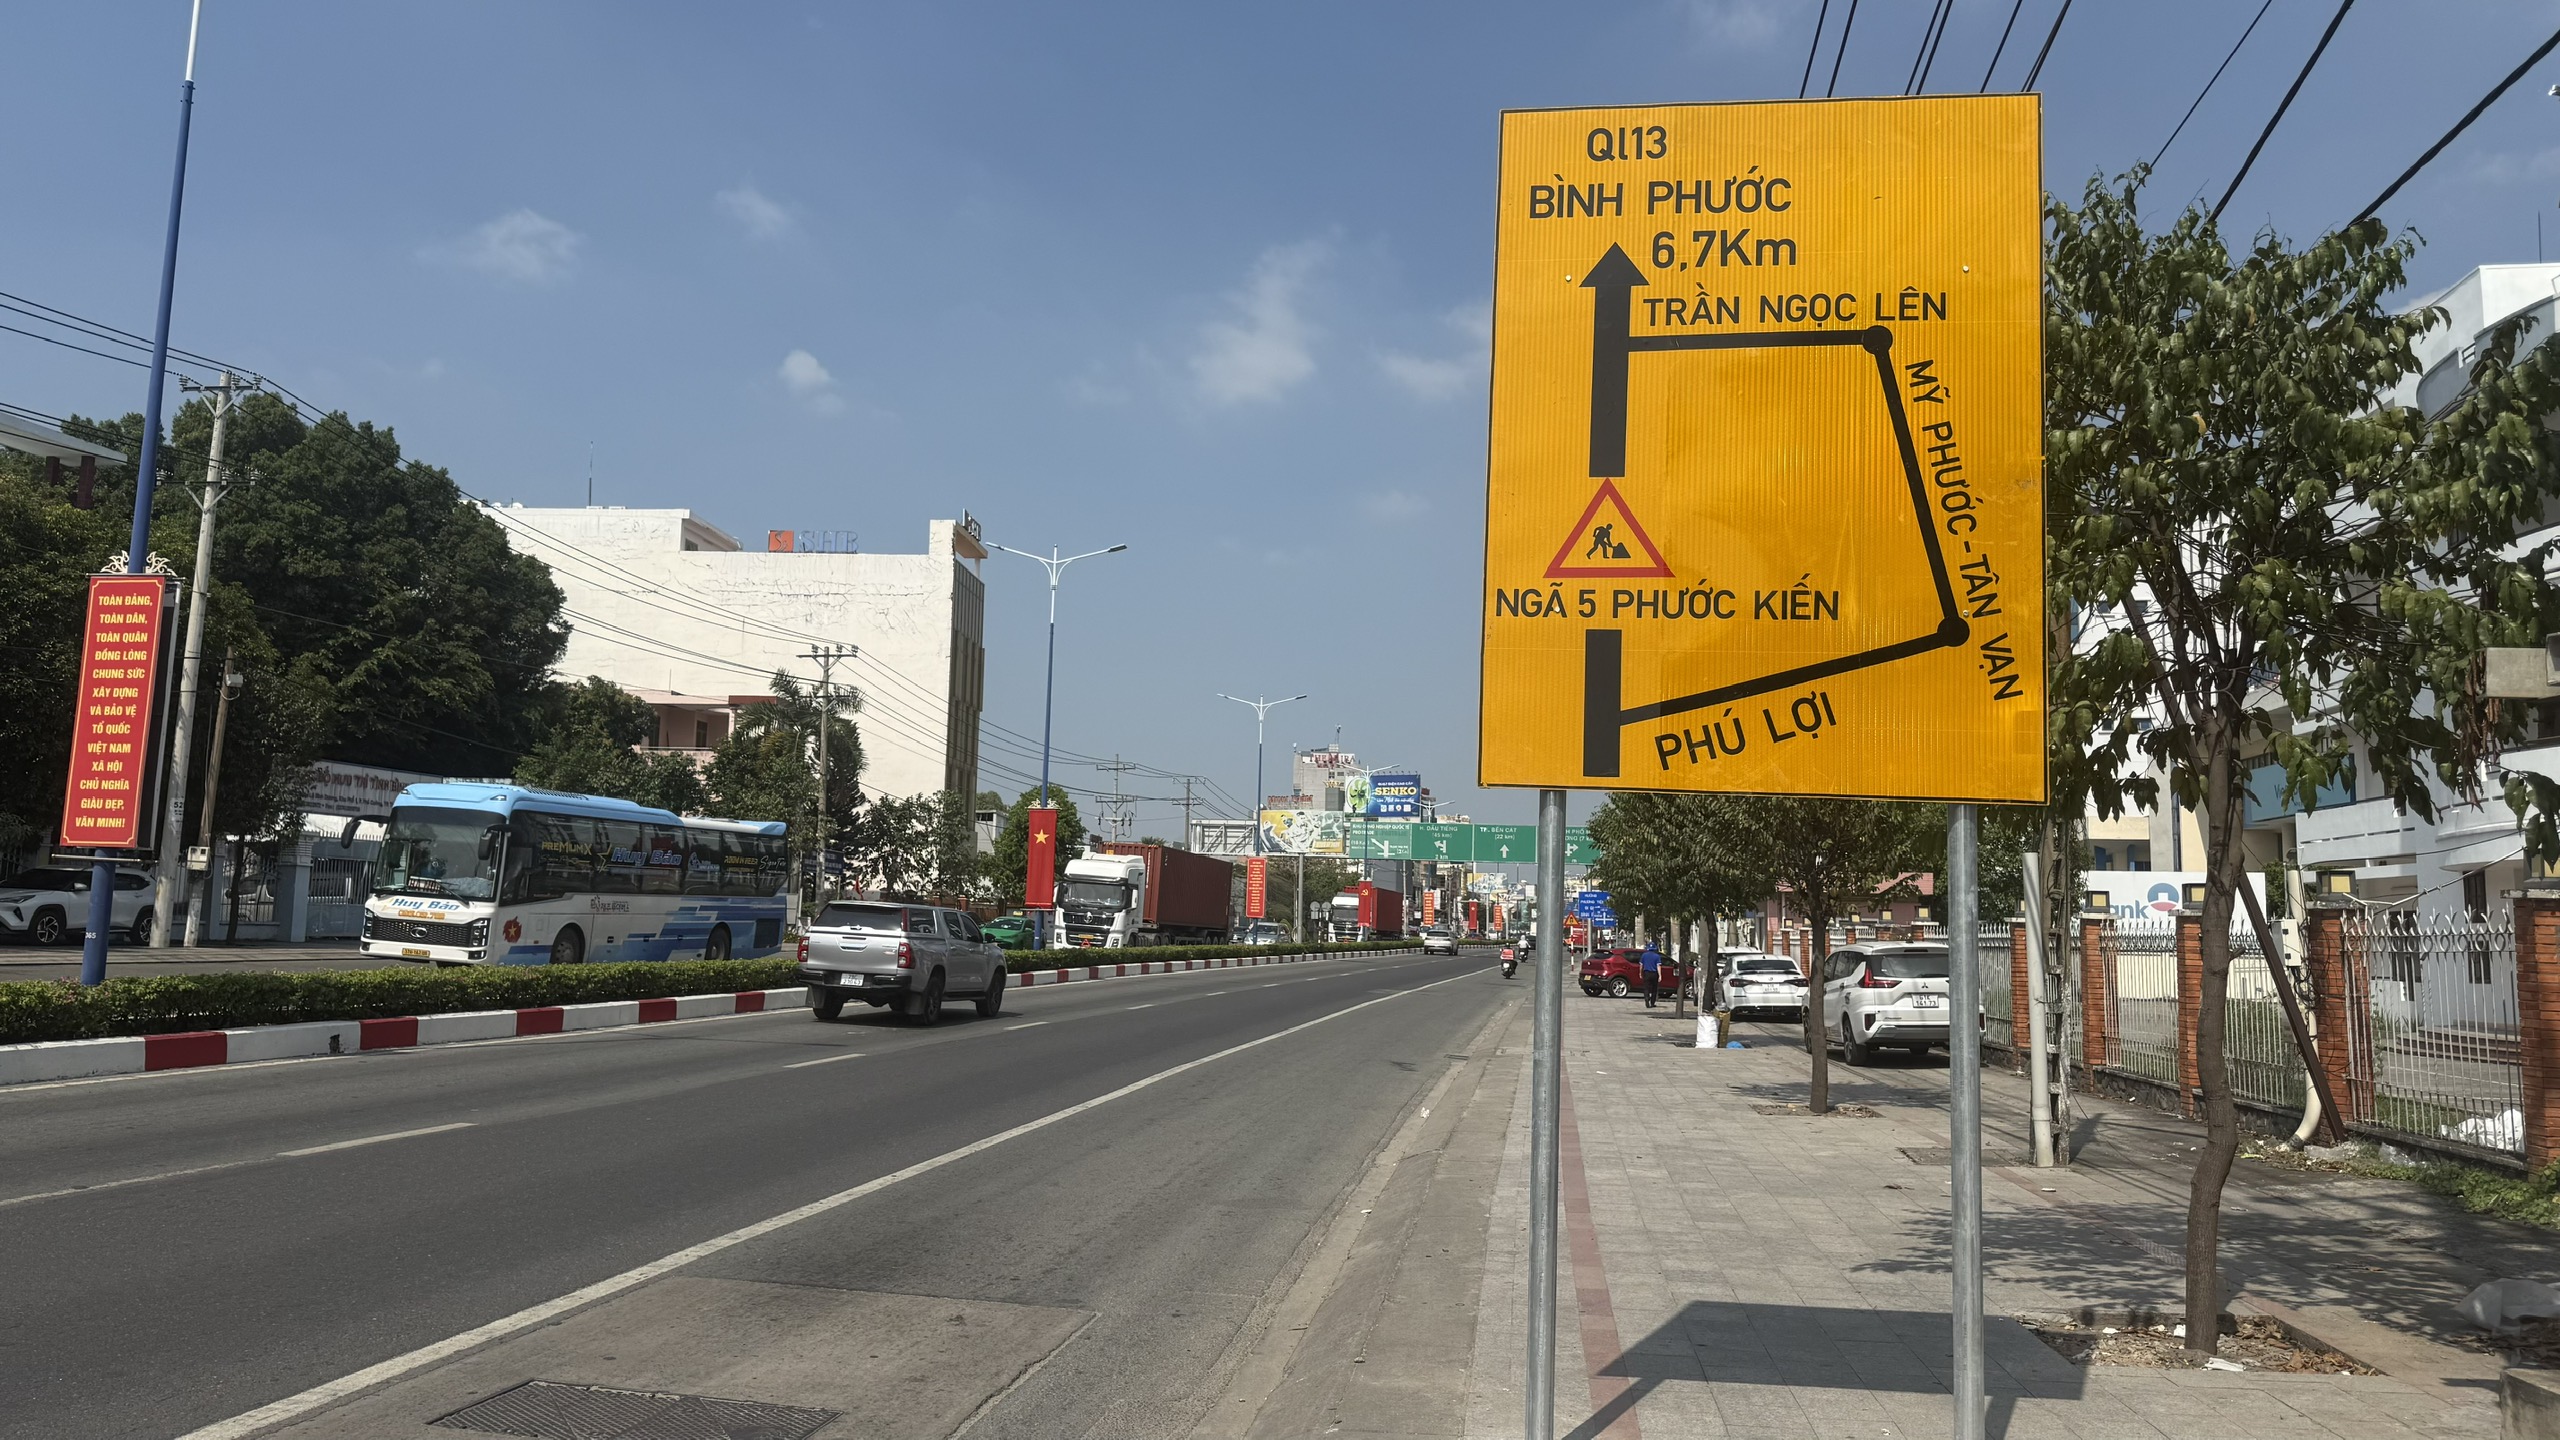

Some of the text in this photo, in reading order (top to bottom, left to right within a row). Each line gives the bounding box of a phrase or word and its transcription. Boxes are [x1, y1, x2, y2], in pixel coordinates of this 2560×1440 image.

[1529, 165, 1793, 219] BÌNH PHƯỚC
[1652, 228, 1796, 273] 6,7Km
[1643, 282, 1947, 329] TRẦN NGỌC LÊN
[1904, 359, 1951, 404] MỸ
[1978, 632, 2024, 702] VẠN
[798, 530, 858, 554] SHB
[98, 592, 153, 607] TOÀN ĐẢNG,
[1495, 572, 1839, 622] NGÃ 5 PHƯỚC KIẾN
[99, 611, 148, 625] TOÀN DÂN,
[95, 630, 149, 644] TOÀN QUÂN
[122, 648, 148, 661] LÒNG
[92, 666, 146, 679] CHUNG SỨC
[92, 685, 139, 700] XÂY DỰNG
[89, 702, 137, 718] VÀ BẢO VỆ
[105, 720, 131, 736] QUỐC
[1654, 690, 1838, 772] PHÚ LỢI
[87, 740, 132, 756] VIỆT NAM
[106, 759, 123, 774] HỘI
[79, 776, 130, 791] CHỦ NGHĨA
[1375, 786, 1417, 796] SENKO
[80, 795, 125, 812] GIÀU ĐẸP,
[75, 815, 126, 828] VĂN MINH!
[611, 846, 646, 866] Huy
[649, 849, 682, 866] Bảo
[391, 897, 461, 911] Huy Bảo
